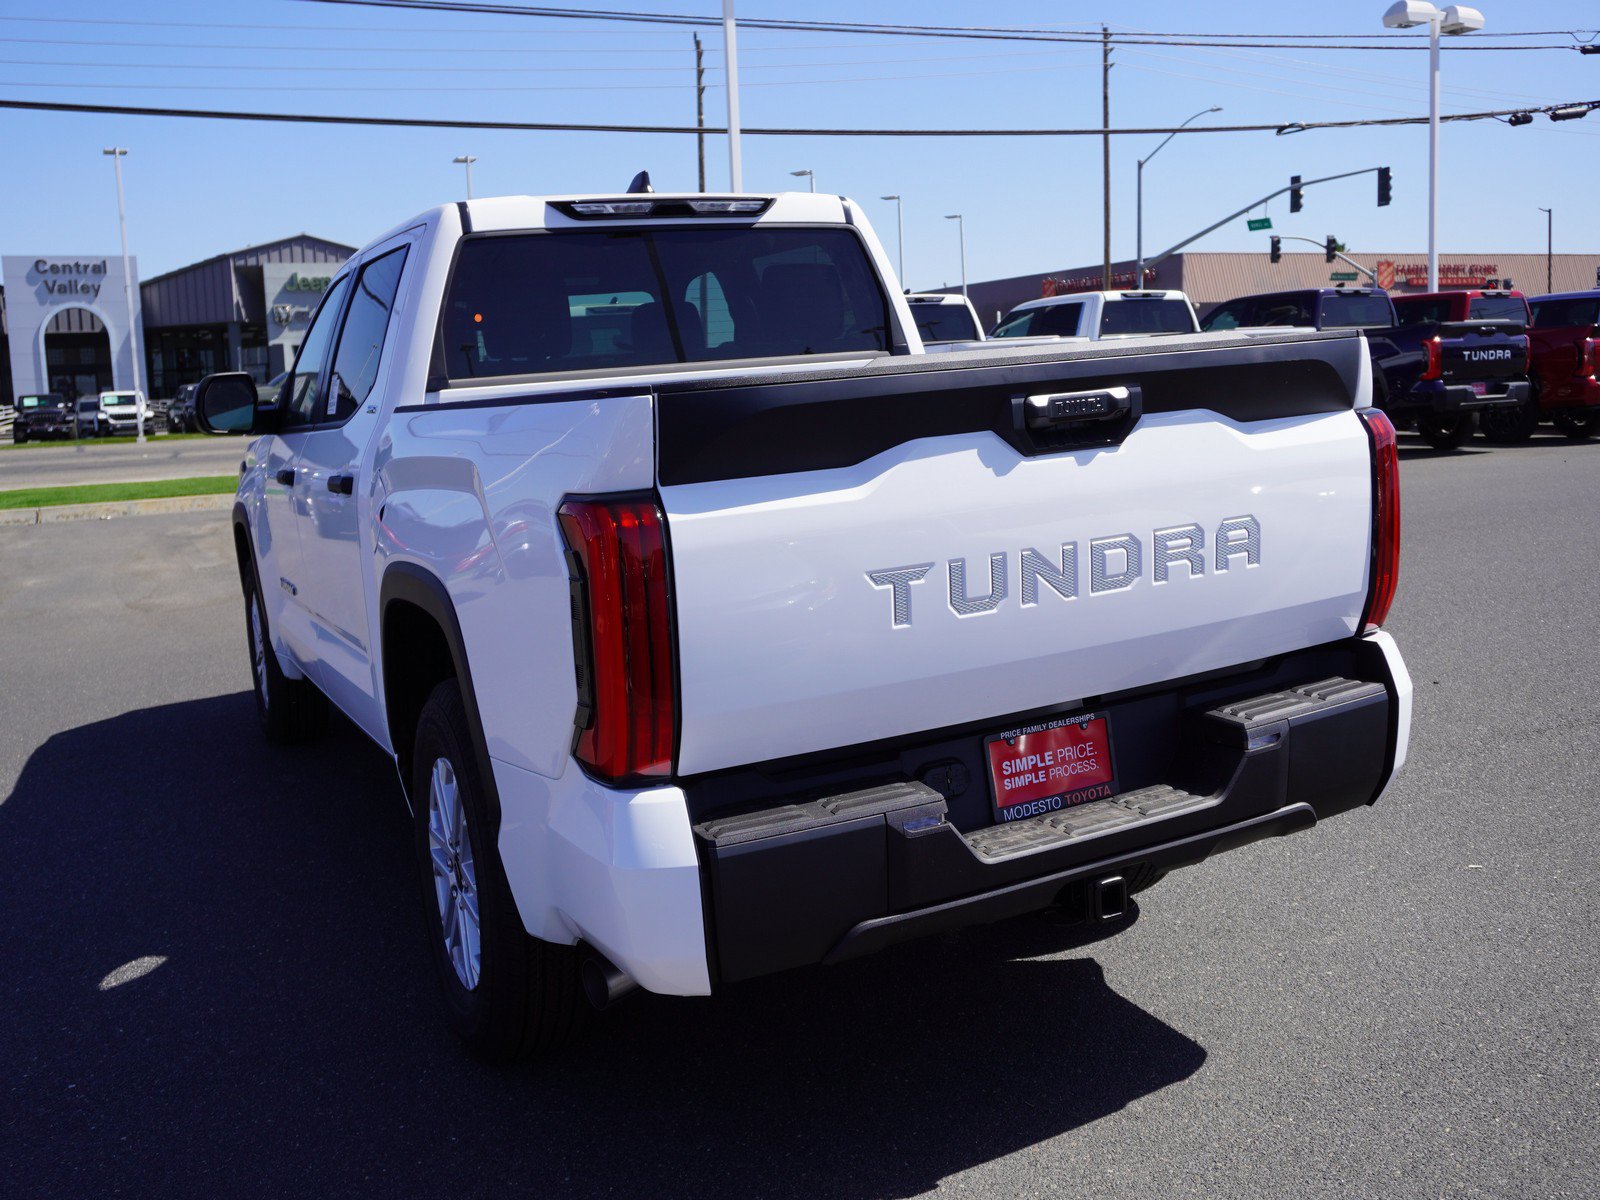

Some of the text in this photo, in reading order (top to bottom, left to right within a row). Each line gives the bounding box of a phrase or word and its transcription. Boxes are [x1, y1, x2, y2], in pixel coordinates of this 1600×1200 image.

[34, 259, 107, 274] Central
[43, 279, 101, 298] Valley
[286, 272, 332, 293] Jeep
[1463, 349, 1512, 361] TUNDRA
[1055, 397, 1104, 415] TOYOTA
[864, 514, 1261, 630] TUNDRA
[1000, 713, 1095, 740] PRICE FAMILY DEALERSHIPS
[1002, 741, 1098, 775] SIMPLE PRICE.
[1004, 758, 1099, 790] SIMPLE PROCESS.
[1004, 785, 1111, 821] MODESTO TOYOTA
